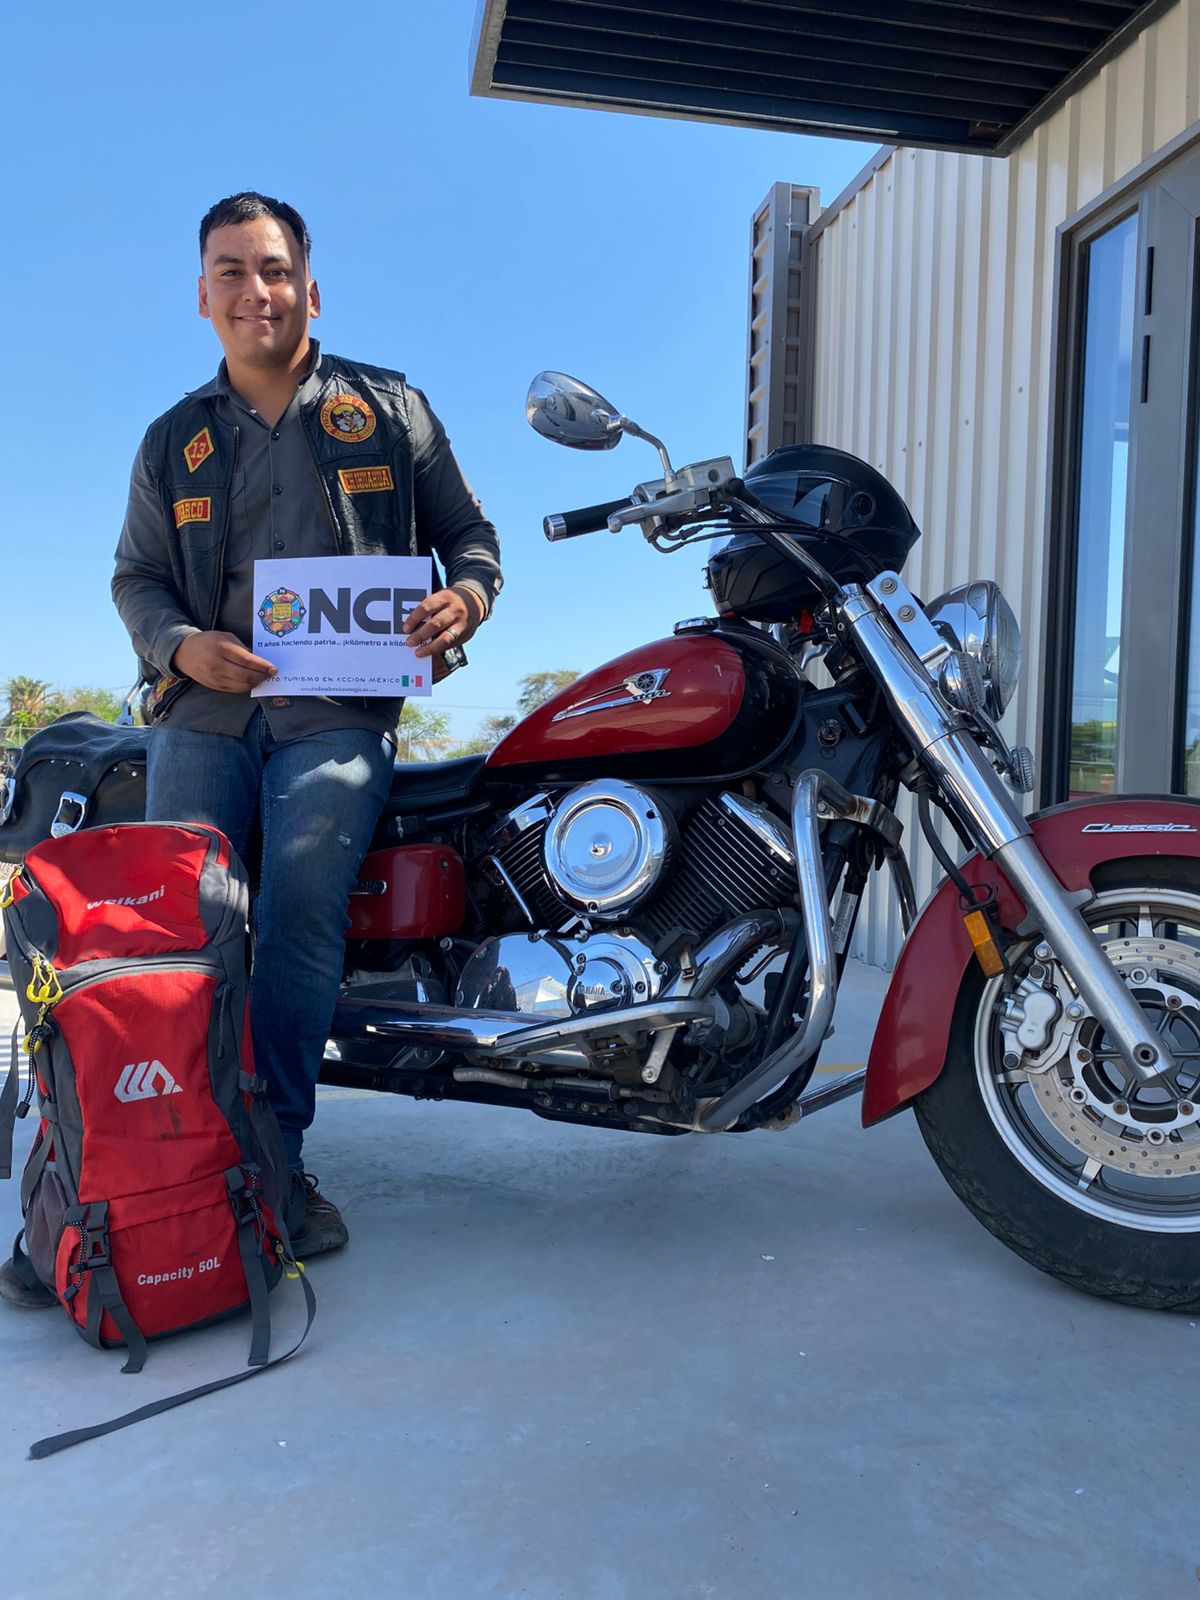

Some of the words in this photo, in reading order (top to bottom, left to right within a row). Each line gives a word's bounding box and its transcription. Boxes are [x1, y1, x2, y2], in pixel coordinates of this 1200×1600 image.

[190, 442, 206, 458] 13
[281, 639, 313, 647] haciendo
[137, 1267, 194, 1285] Capacity
[198, 1256, 221, 1273] 50L
